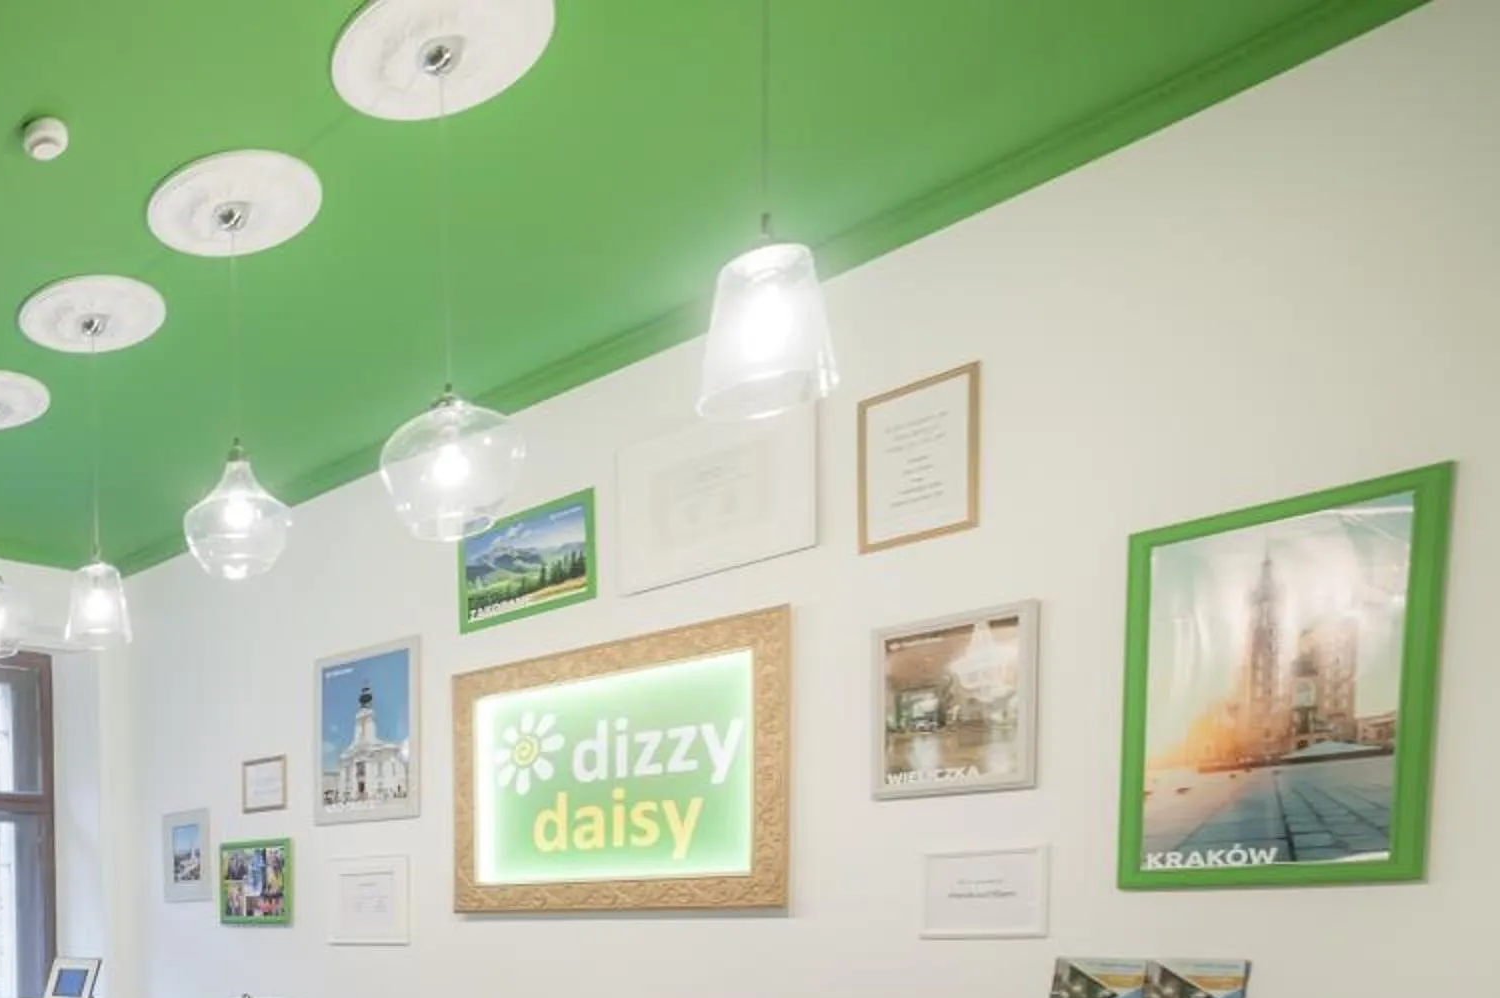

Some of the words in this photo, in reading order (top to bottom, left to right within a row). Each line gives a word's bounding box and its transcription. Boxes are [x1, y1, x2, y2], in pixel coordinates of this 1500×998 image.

[572, 715, 744, 785] dizzy
[533, 787, 704, 859] daisy
[1146, 844, 1279, 870] KRAKÓW
